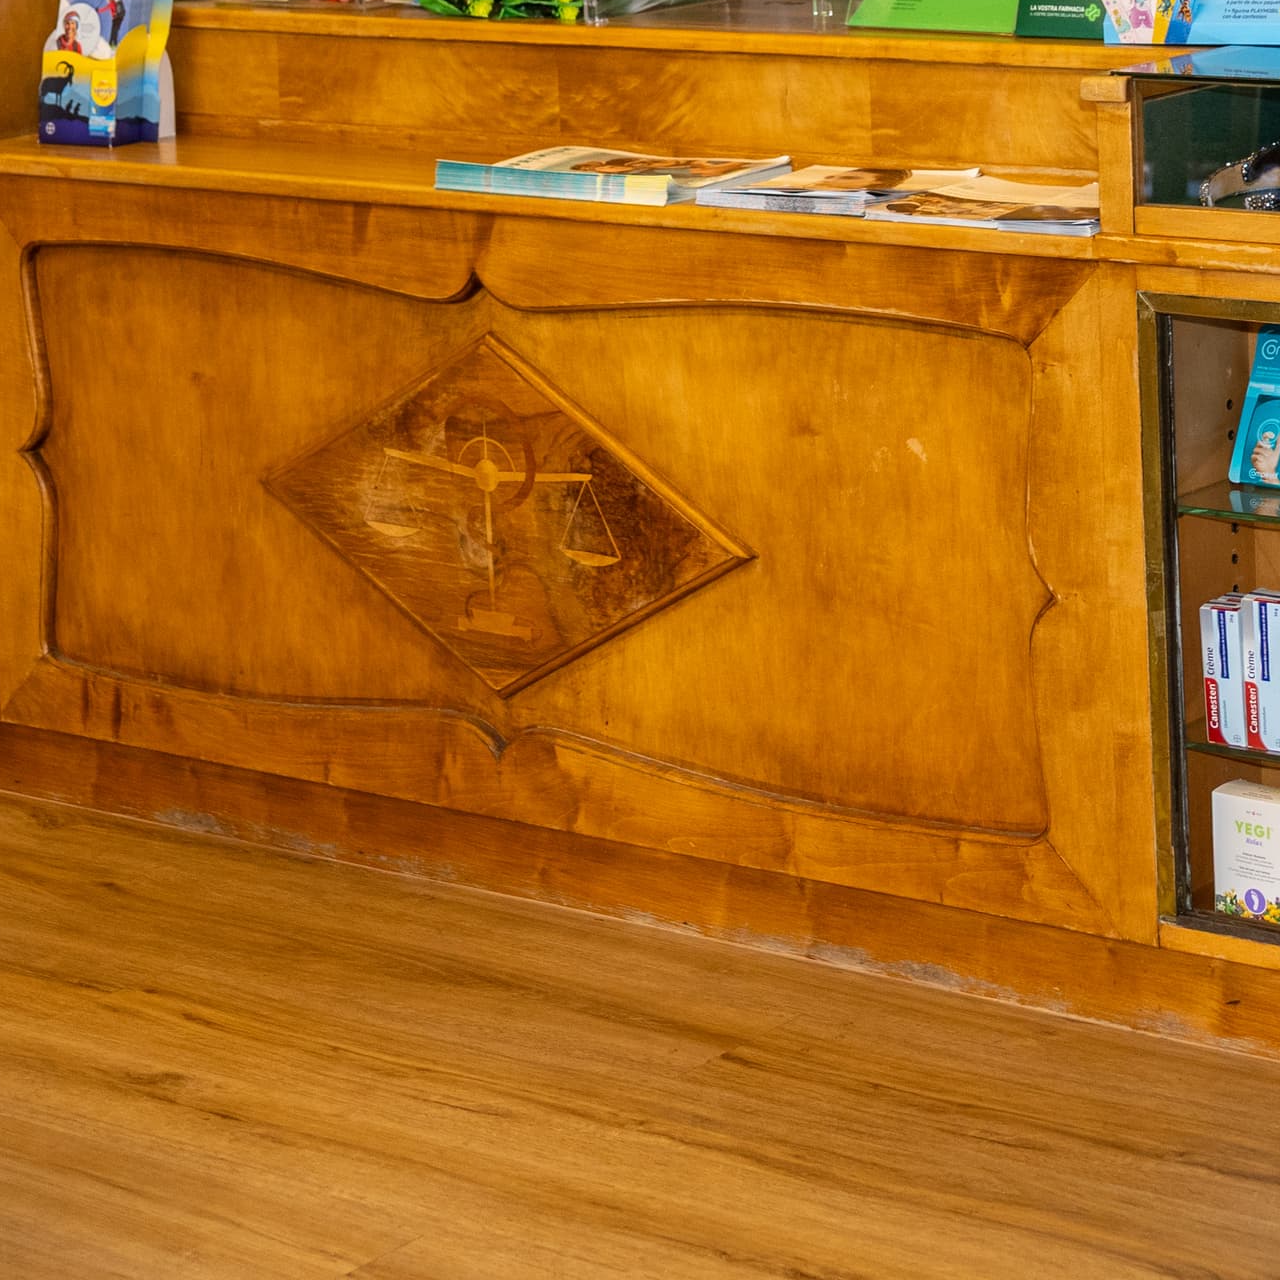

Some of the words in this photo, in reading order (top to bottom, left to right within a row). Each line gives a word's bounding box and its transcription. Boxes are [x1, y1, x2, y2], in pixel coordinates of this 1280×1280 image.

[1207, 647, 1215, 675] Crème
[1247, 650, 1256, 679] Crème
[1209, 683, 1220, 729] Canesten
[1248, 687, 1259, 734] Canesten
[1235, 820, 1271, 839] YEGI
